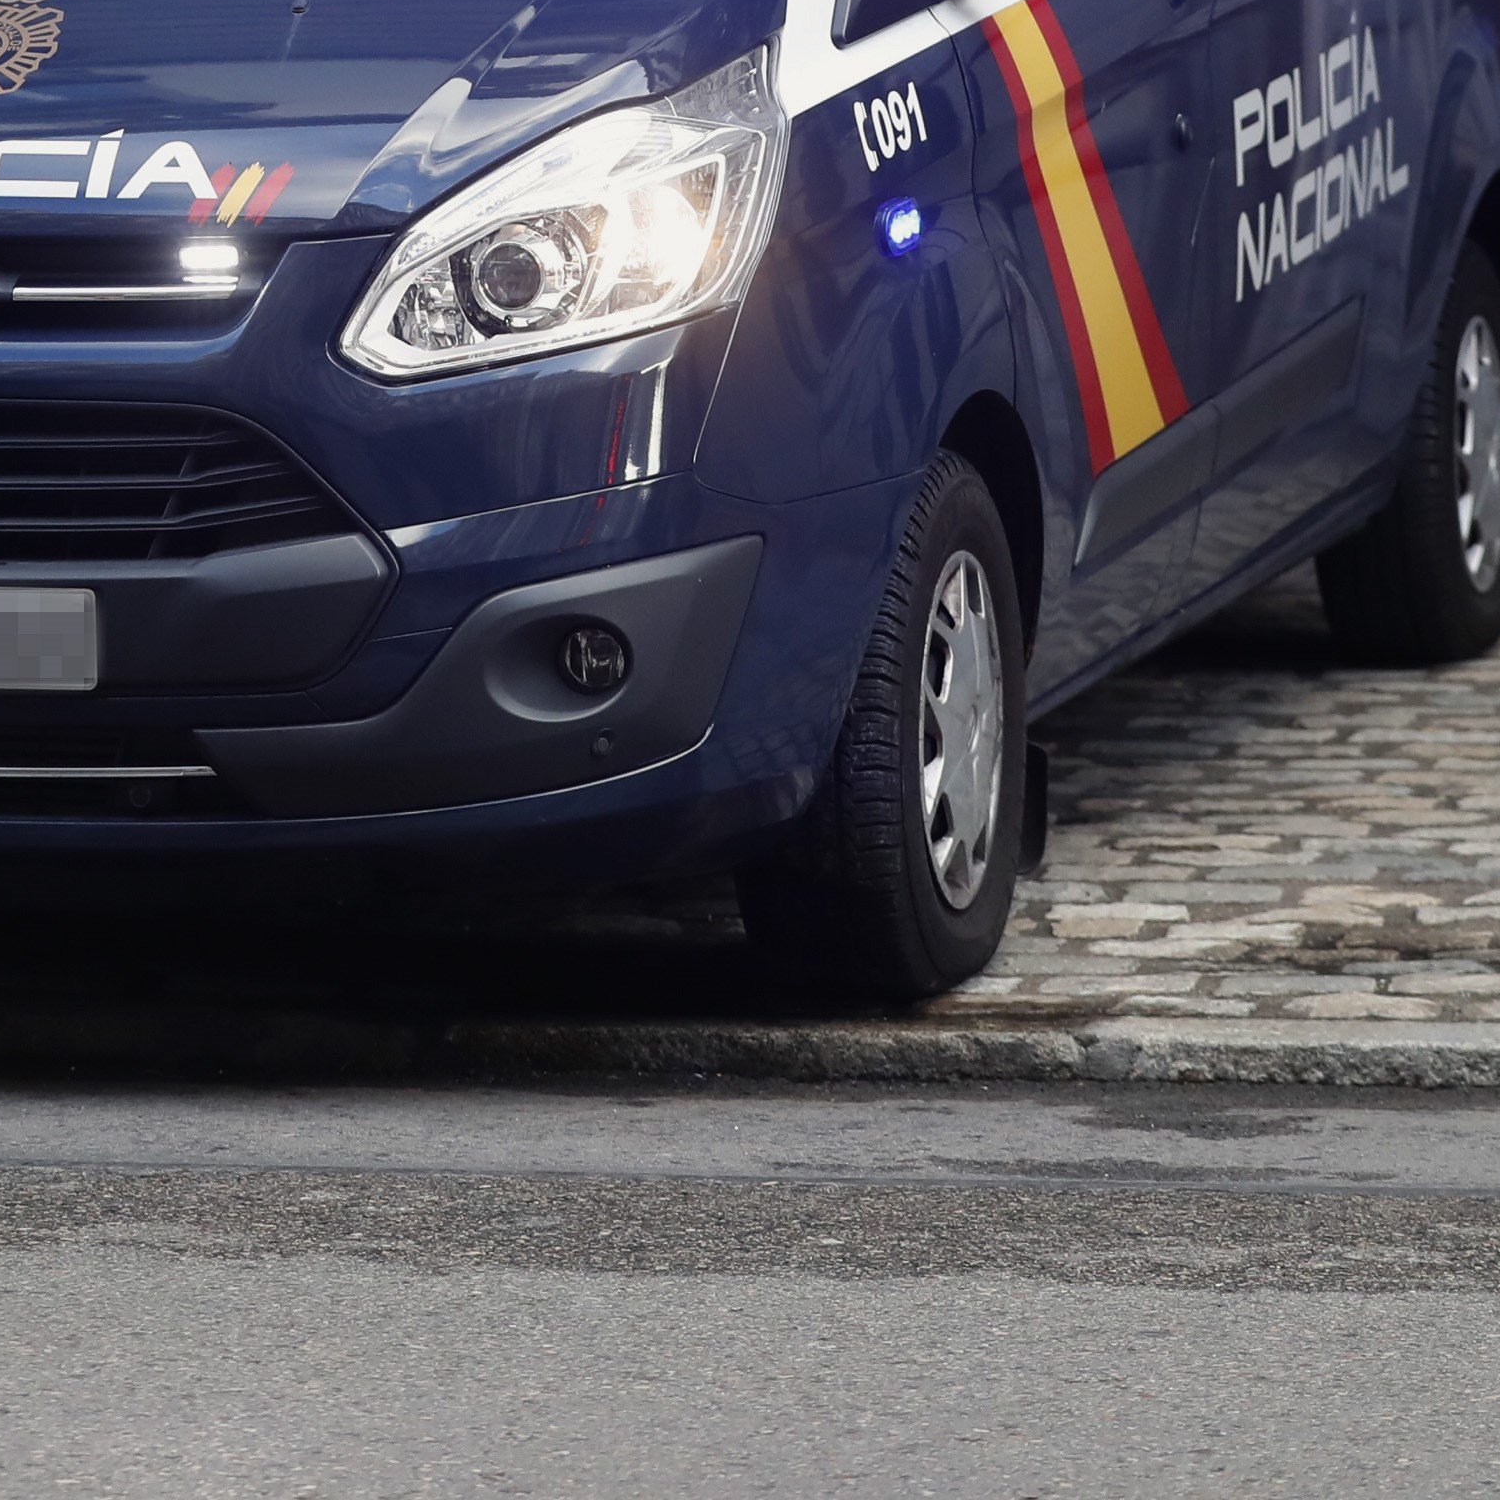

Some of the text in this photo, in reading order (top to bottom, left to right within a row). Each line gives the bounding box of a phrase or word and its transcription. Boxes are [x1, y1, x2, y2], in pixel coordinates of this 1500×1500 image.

[871, 82, 927, 159] 091
[1233, 10, 1380, 187] POLICÍA
[1236, 117, 1409, 302] NACIONAL
